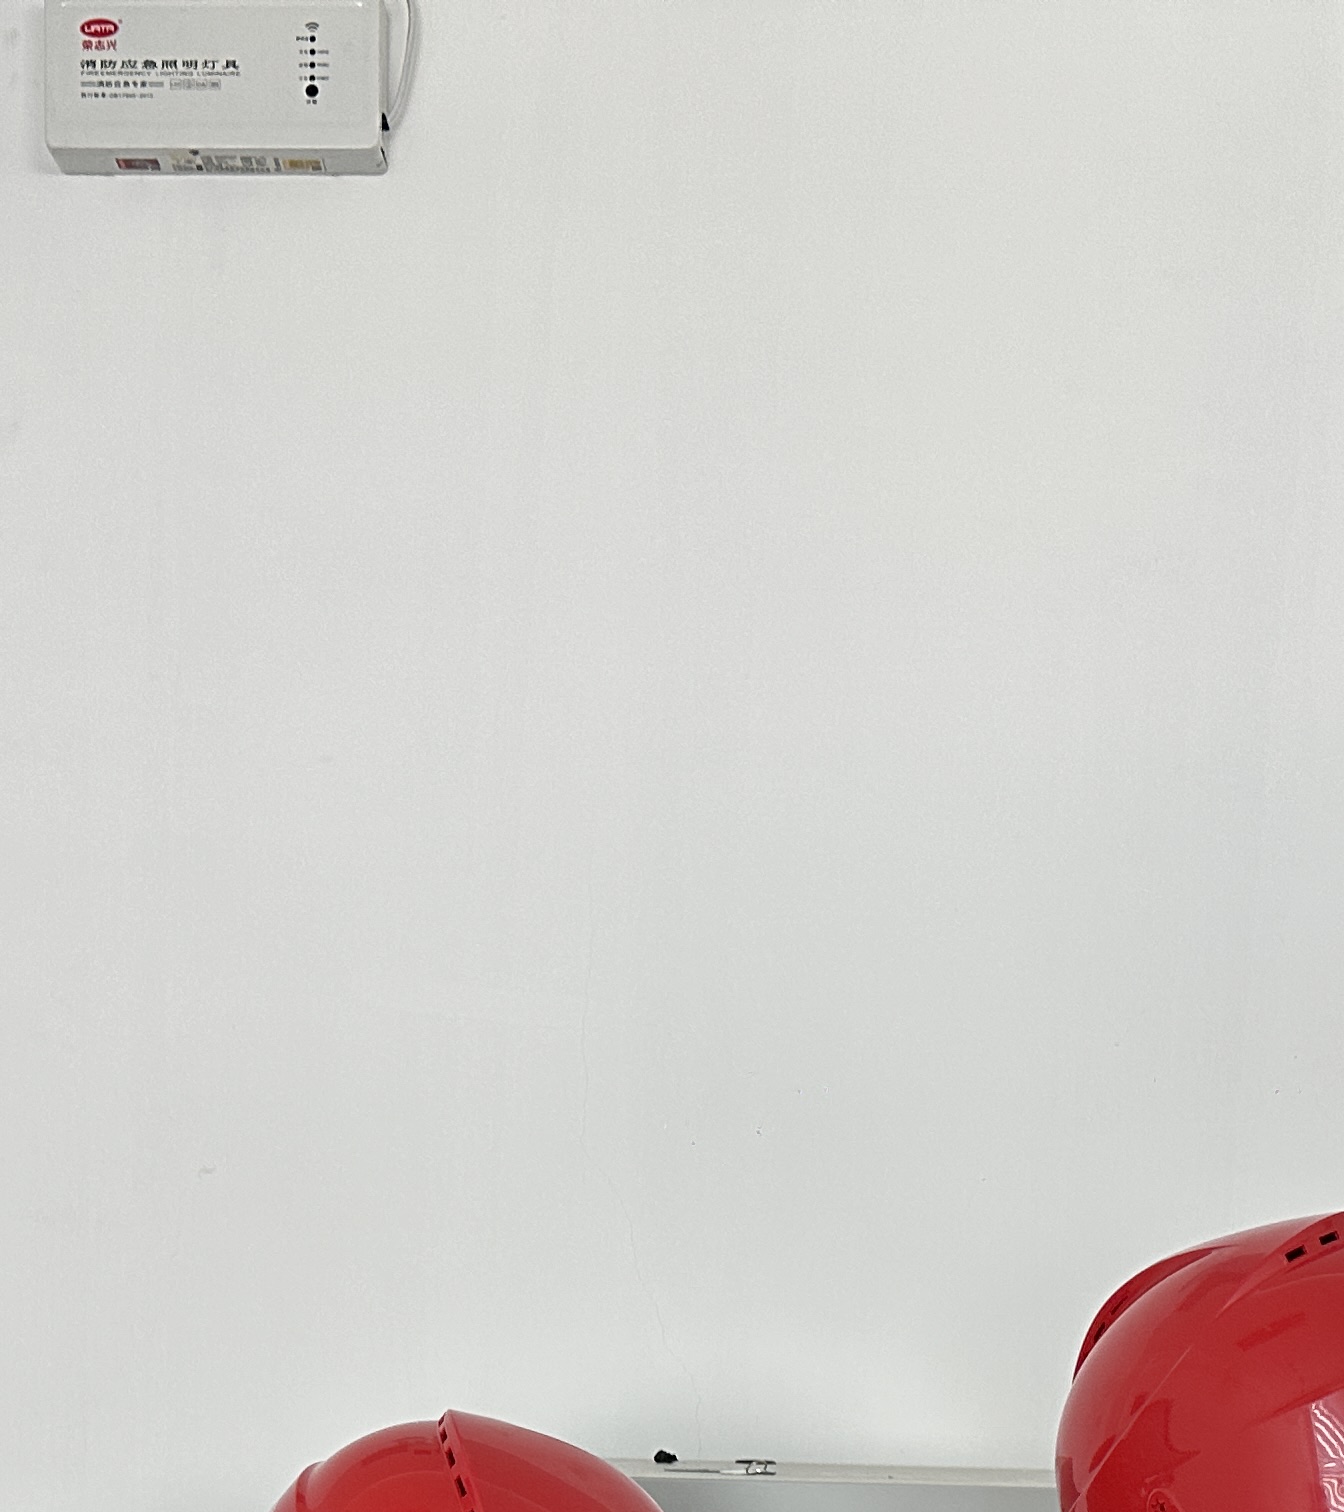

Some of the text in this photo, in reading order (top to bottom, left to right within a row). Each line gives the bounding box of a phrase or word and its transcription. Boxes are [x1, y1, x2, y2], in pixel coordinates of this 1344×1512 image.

[80, 59, 240, 70] 消防应急照明灯具
